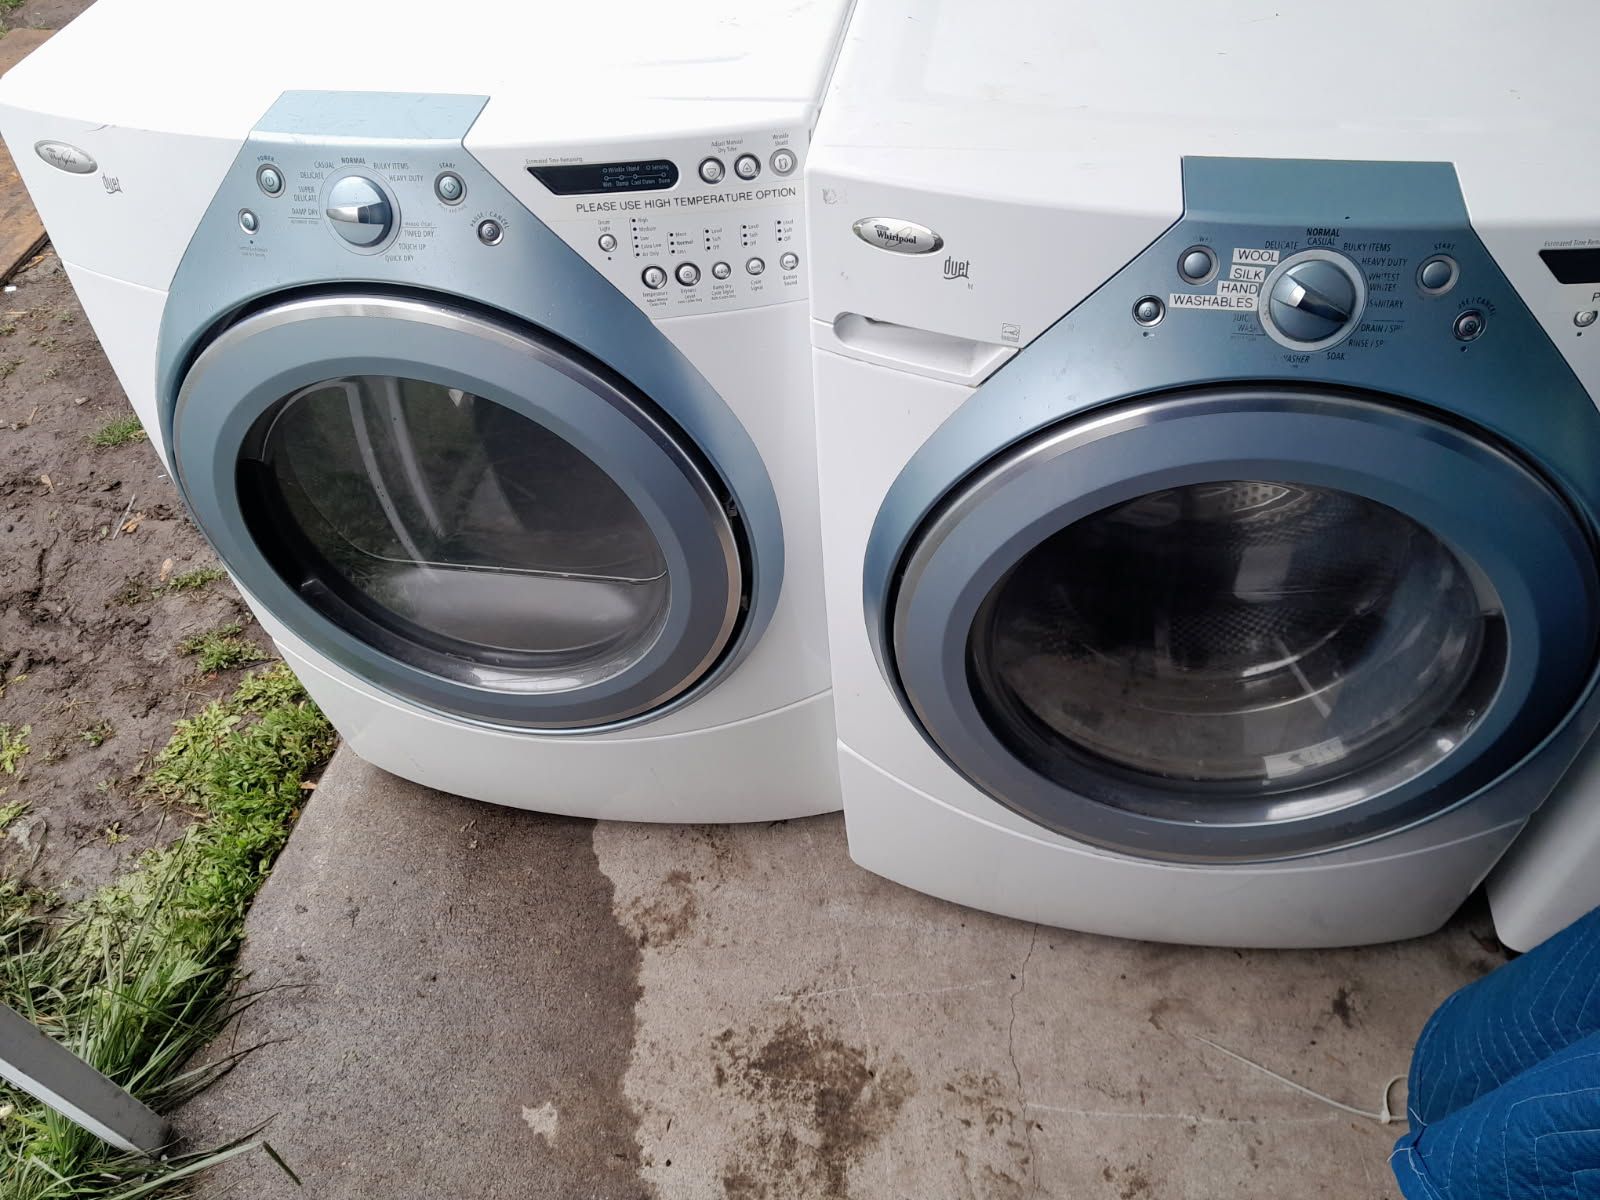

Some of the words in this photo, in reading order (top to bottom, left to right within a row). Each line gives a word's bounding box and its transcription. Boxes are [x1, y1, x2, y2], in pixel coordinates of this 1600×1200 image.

[373, 162, 390, 170] BULKY
[392, 162, 409, 170] ITEMS
[300, 172, 324, 180] DELICATE
[294, 194, 318, 202] DELICATE
[576, 202, 617, 213] PLEASE
[620, 200, 642, 210] USE
[644, 197, 671, 209] HIGH
[674, 191, 753, 207] TEMPERATURE
[755, 187, 796, 200] OPTION
[292, 208, 307, 216] DAMP
[308, 208, 318, 216] DRY
[404, 230, 421, 238] TIMED
[423, 230, 435, 238] DRY
[876, 230, 917, 244] Whirlpool
[1306, 228, 1340, 237] NORMAL
[1264, 240, 1300, 250] DELICATE
[1307, 237, 1336, 246] CASUAL
[418, 243, 427, 251] UP
[1343, 242, 1366, 251] BULKY
[1368, 243, 1391, 252] ITEMS
[1238, 249, 1278, 262] WOOL
[1362, 258, 1386, 266] HEAVY
[1387, 258, 1408, 266] DUTY
[944, 256, 970, 278] duet
[1233, 268, 1263, 280] SILK
[1221, 282, 1258, 295] HAND
[1174, 295, 1253, 308] WASHABLES
[1361, 324, 1384, 333] DRAIN
[1348, 339, 1369, 348] RINSE
[1327, 352, 1345, 360] SOAK
